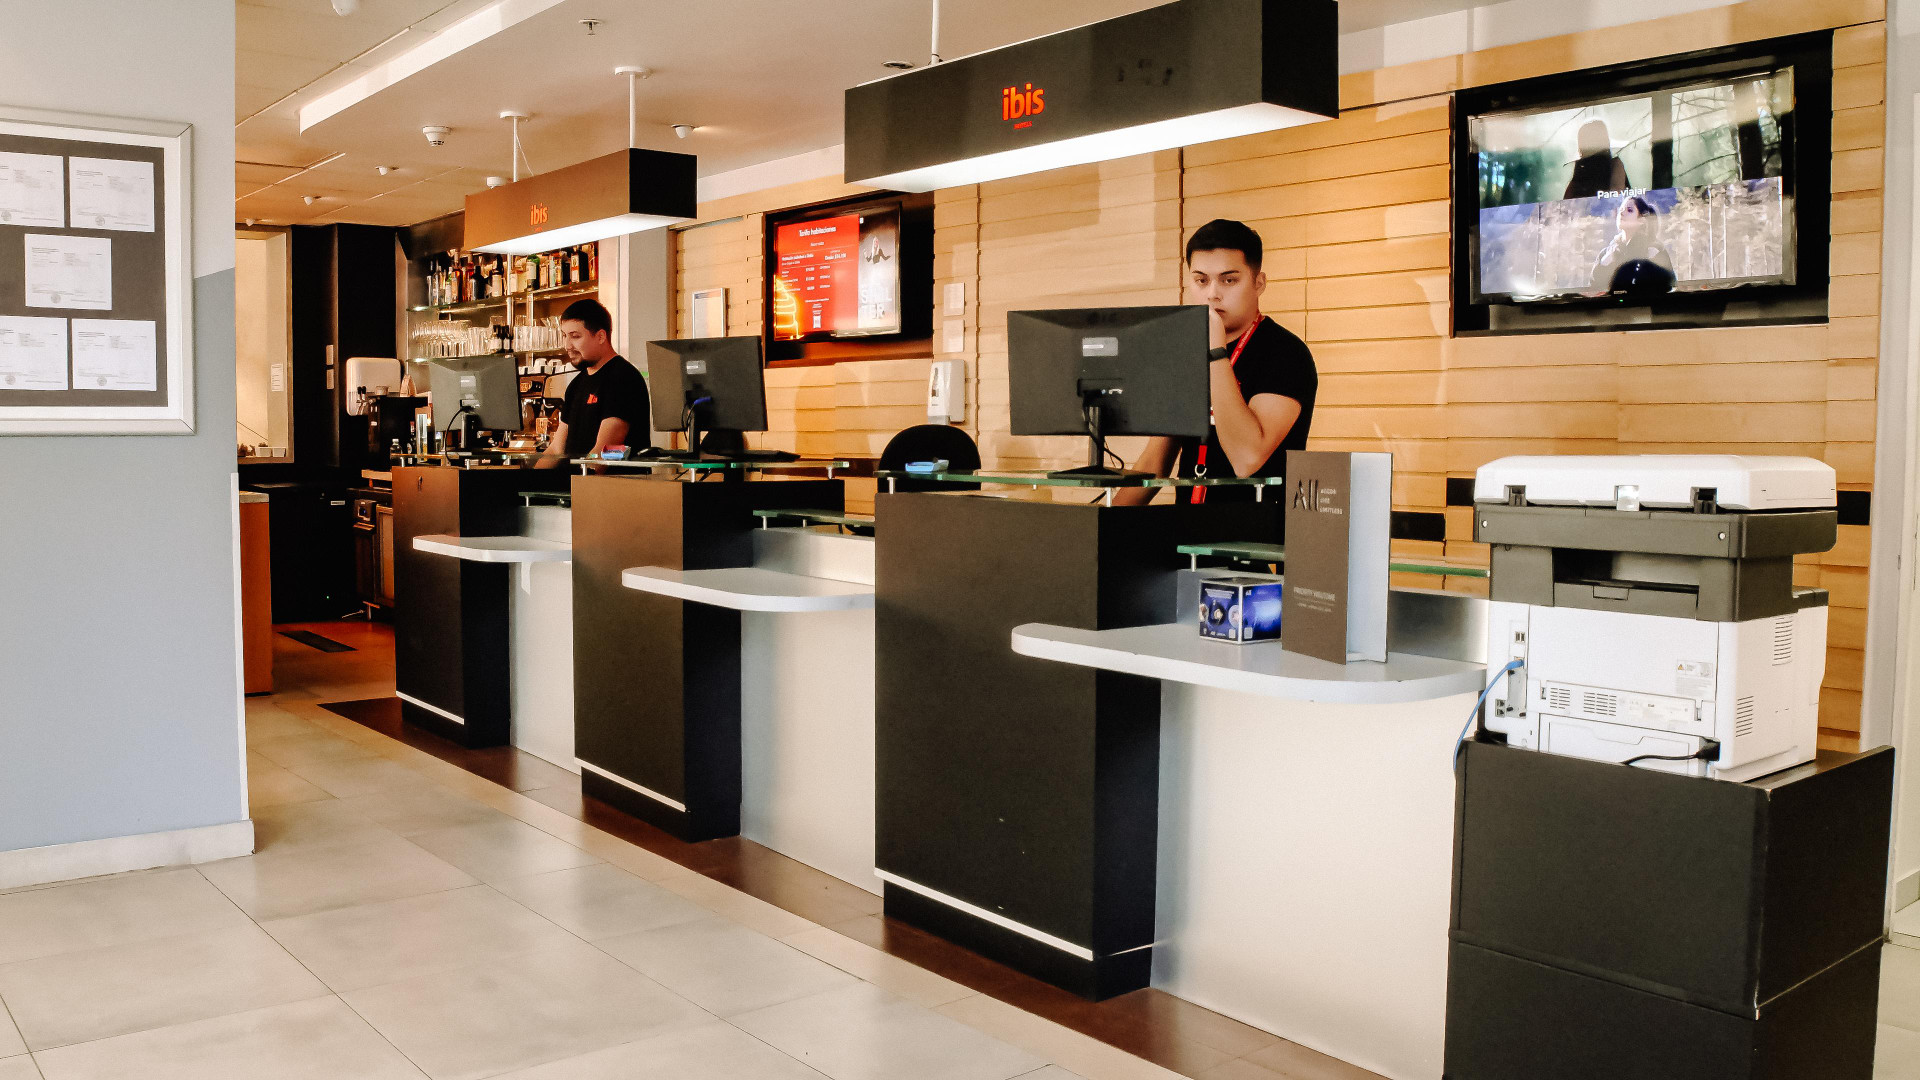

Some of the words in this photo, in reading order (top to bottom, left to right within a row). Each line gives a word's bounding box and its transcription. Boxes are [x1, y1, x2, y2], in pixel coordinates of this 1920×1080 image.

[1002, 82, 1045, 121] ibis
[1597, 190, 1618, 199] Para
[1620, 187, 1647, 198] viajar
[530, 202, 548, 226] ibis
